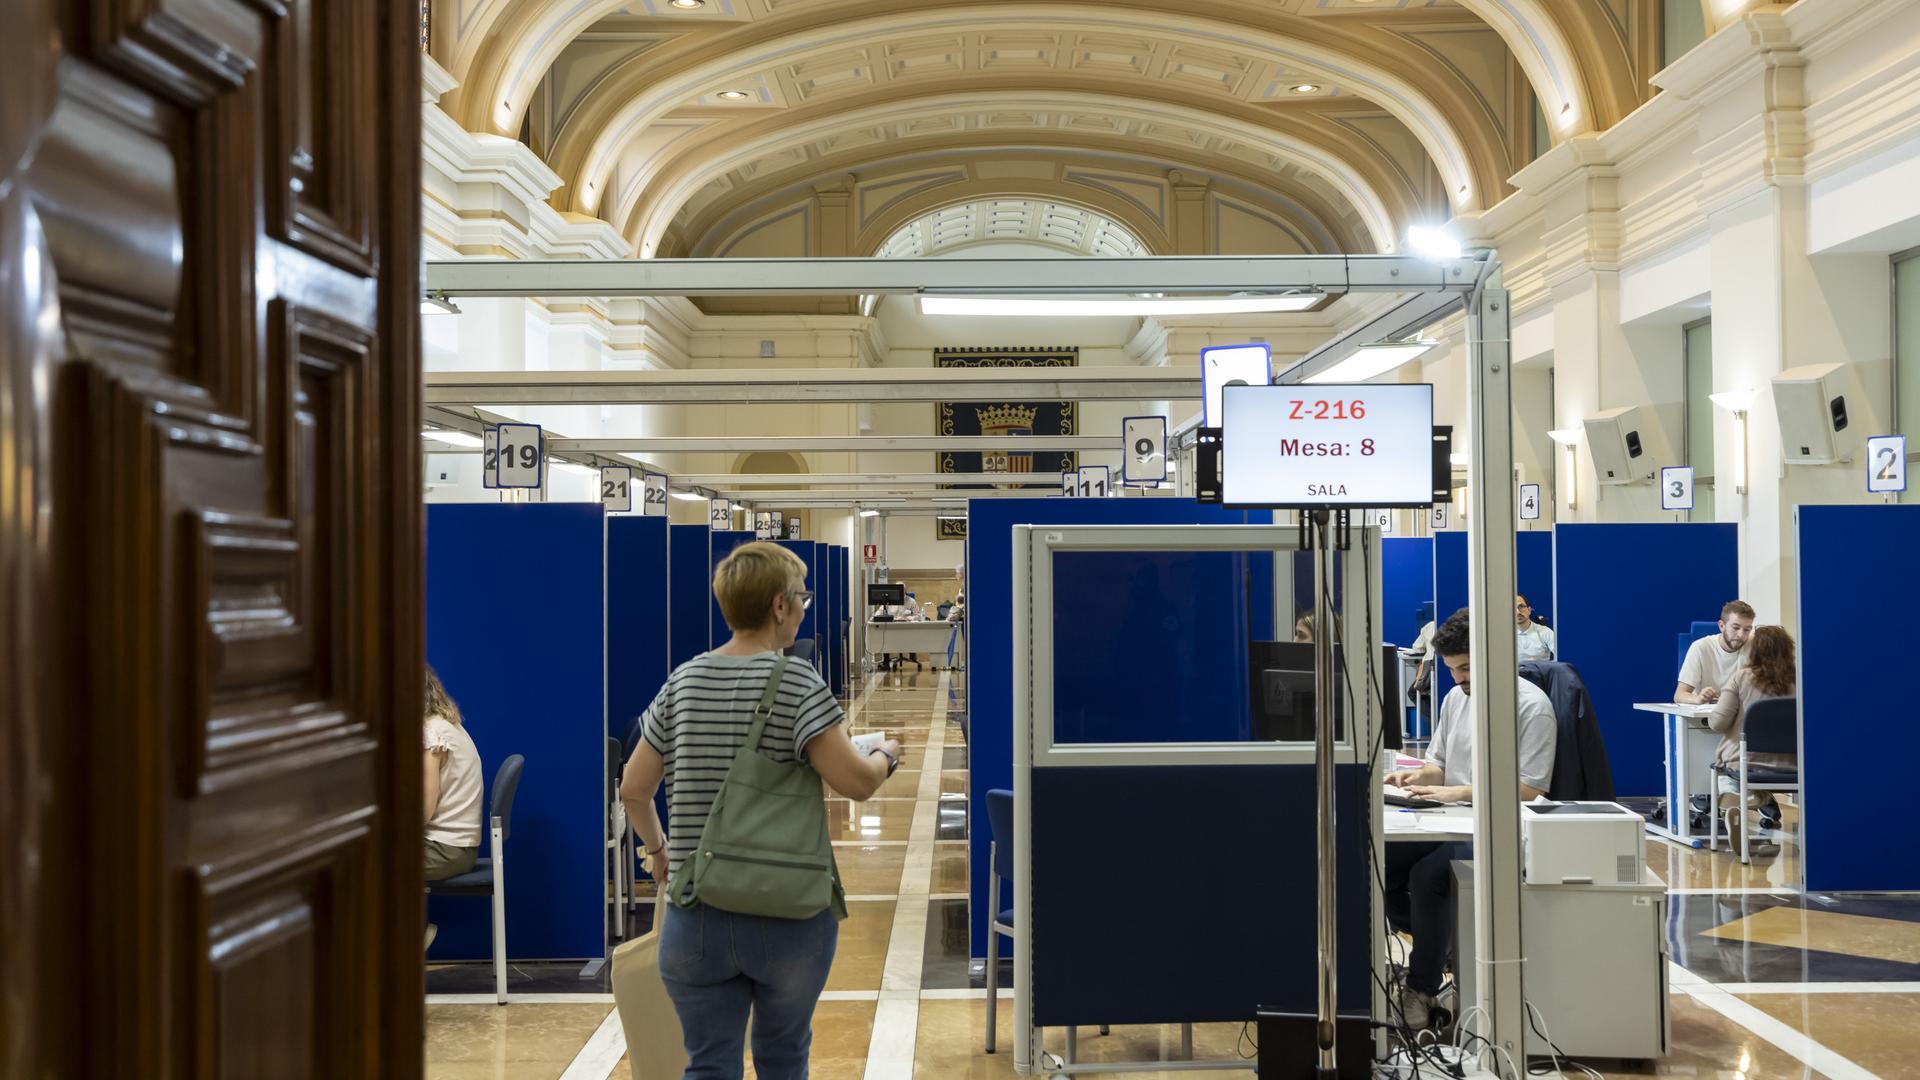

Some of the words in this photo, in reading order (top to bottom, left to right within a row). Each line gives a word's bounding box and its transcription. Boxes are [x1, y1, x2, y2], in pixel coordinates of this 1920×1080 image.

[1288, 400, 1366, 420] Z-216
[1135, 438, 1154, 464] 9
[1280, 438, 1350, 457] Mesa:
[1360, 438, 1375, 457] 8
[500, 444, 538, 469] 19
[1876, 447, 1897, 480] 2
[602, 481, 627, 498] 21
[646, 487, 666, 504] 22
[1080, 480, 1105, 497] 11
[1307, 484, 1348, 496] SALA
[1670, 481, 1684, 498] 3
[1525, 496, 1534, 510] 4
[713, 508, 728, 521] 23
[1379, 515, 1387, 526] 6
[1435, 509, 1443, 520] 5
[756, 520, 770, 531] 25
[772, 519, 781, 529] 26
[790, 525, 799, 534] 27
